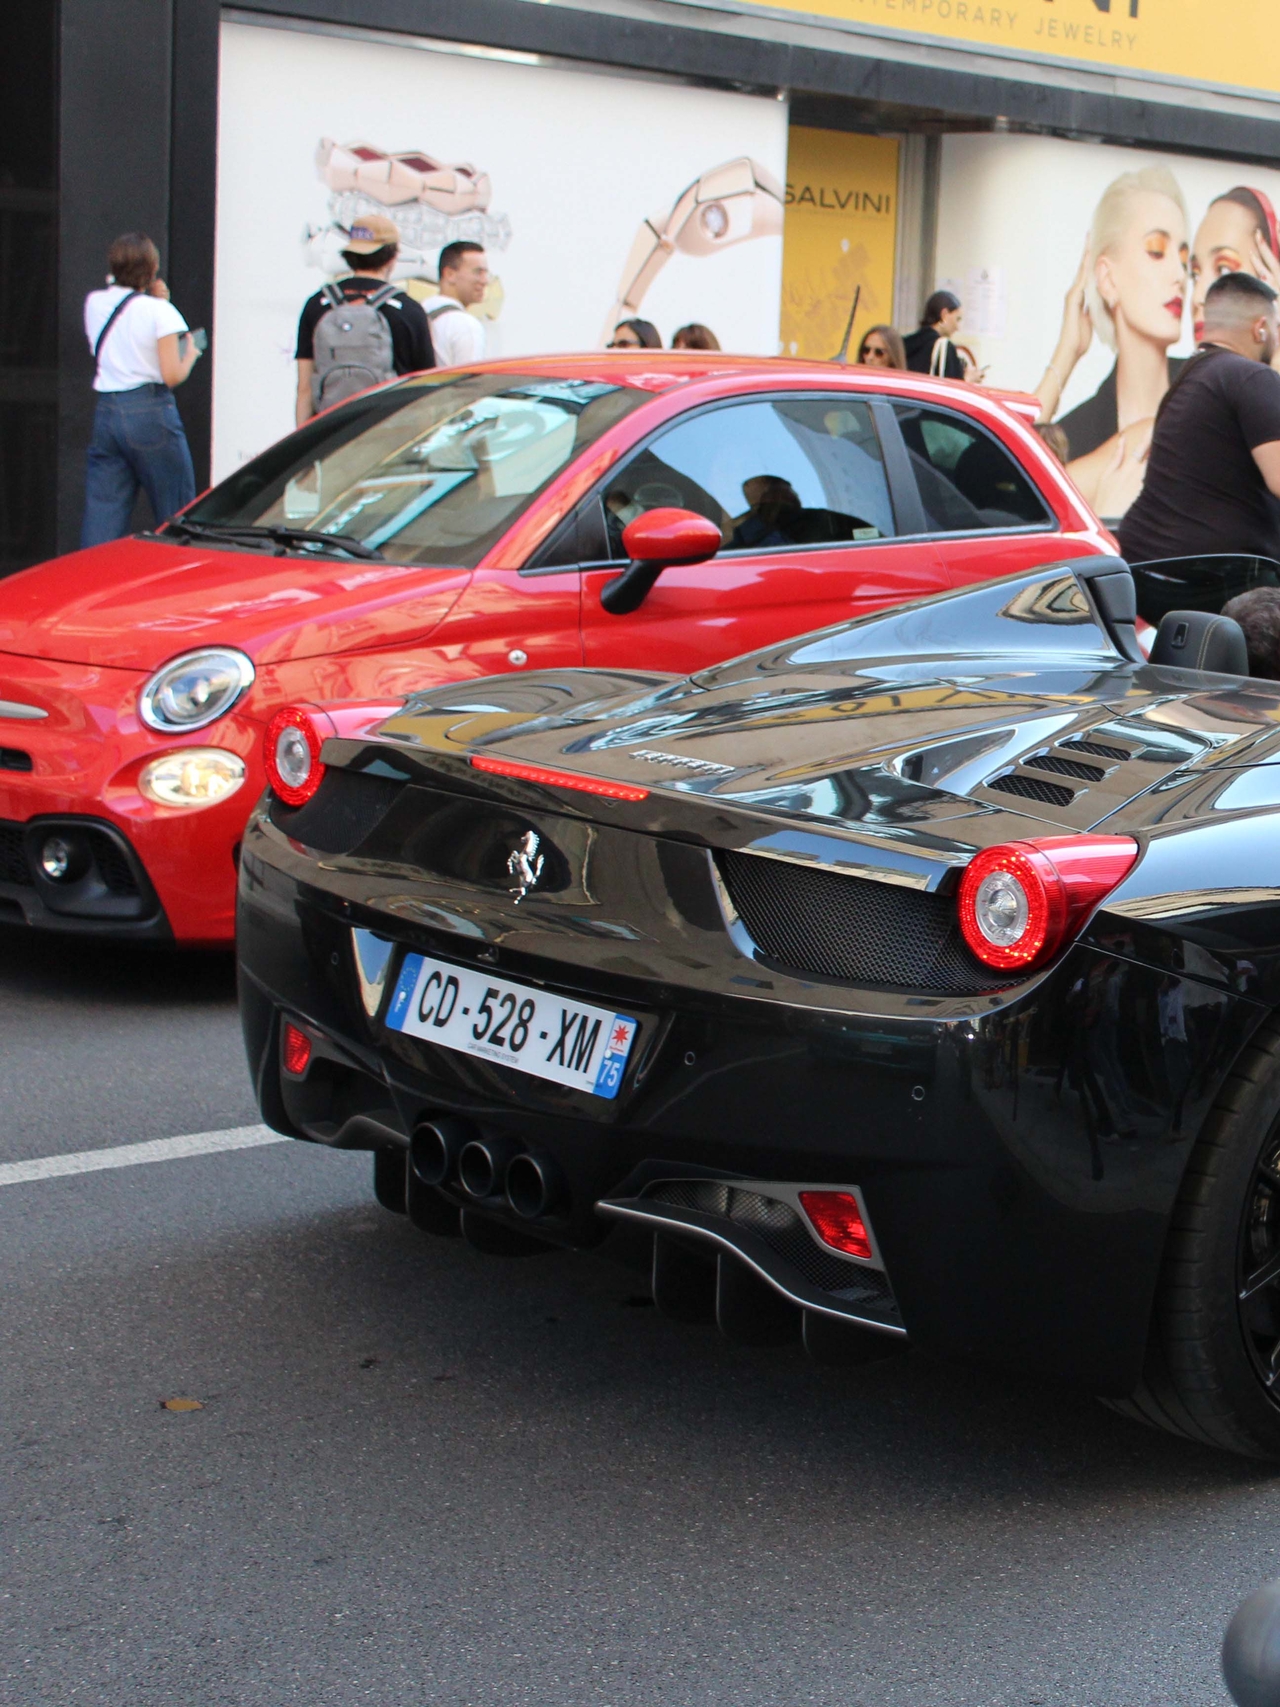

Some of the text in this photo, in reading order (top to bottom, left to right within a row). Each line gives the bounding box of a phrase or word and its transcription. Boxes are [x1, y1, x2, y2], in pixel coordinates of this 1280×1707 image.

[1034, 17, 1137, 51] JEWELRY
[784, 183, 890, 214] SALVINI
[600, 1060, 621, 1087] 75
